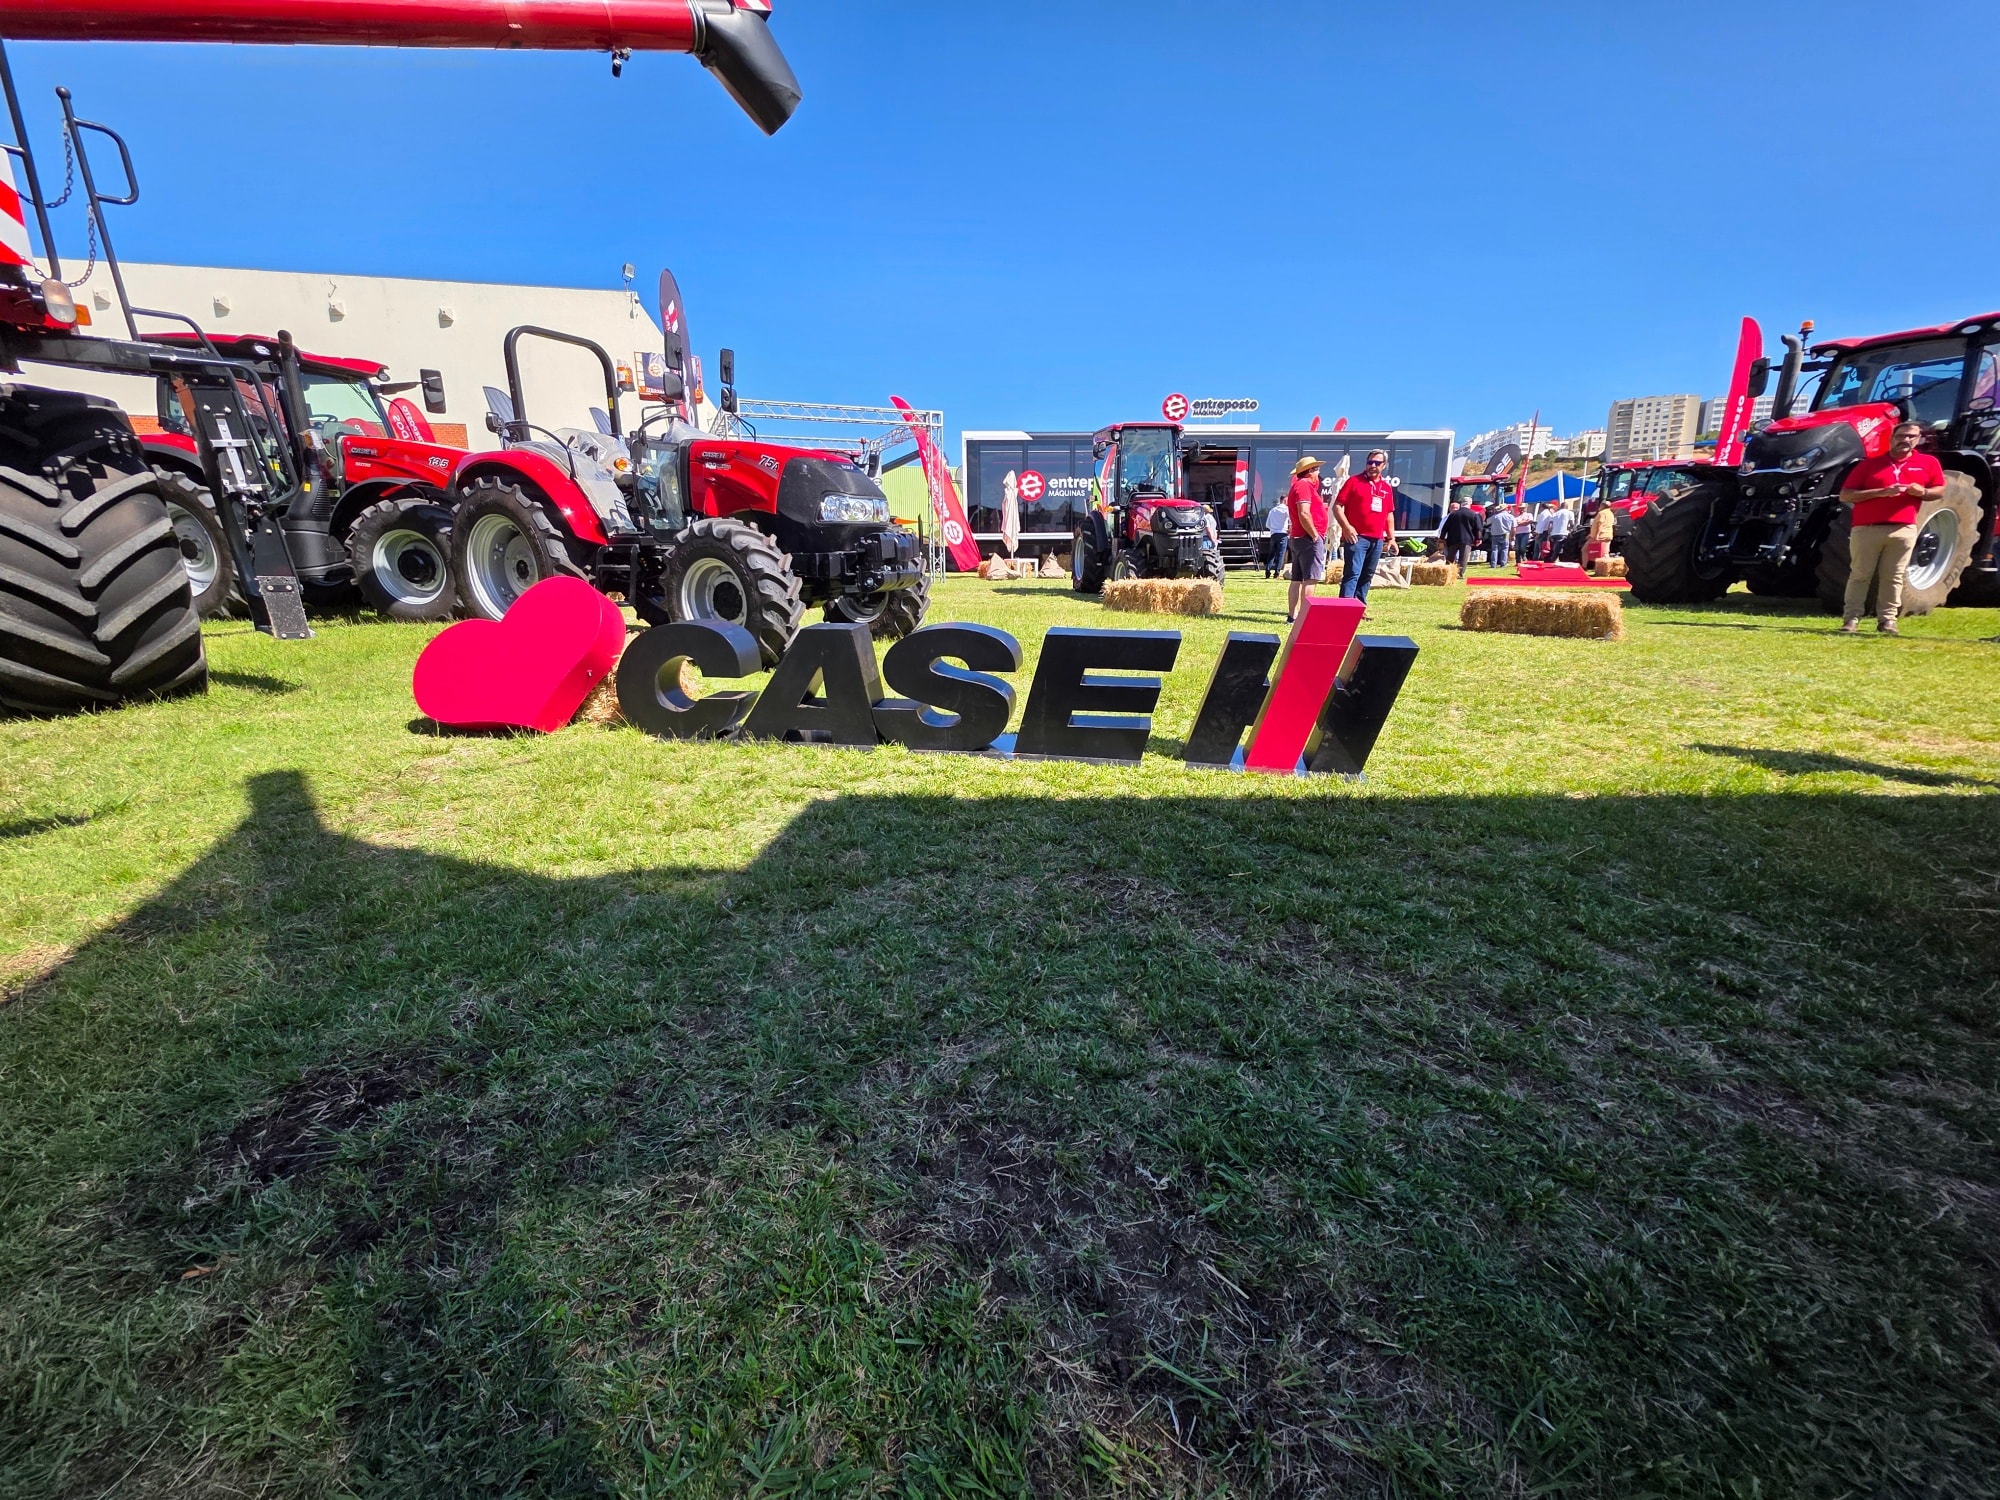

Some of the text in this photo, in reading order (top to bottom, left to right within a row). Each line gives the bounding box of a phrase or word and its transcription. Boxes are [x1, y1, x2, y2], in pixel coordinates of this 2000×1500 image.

[1191, 399, 1258, 411] entreposto
[428, 456, 449, 468] 135
[1048, 489, 1086, 497] MÁQUINAS
[616, 620, 1180, 768] CASE
